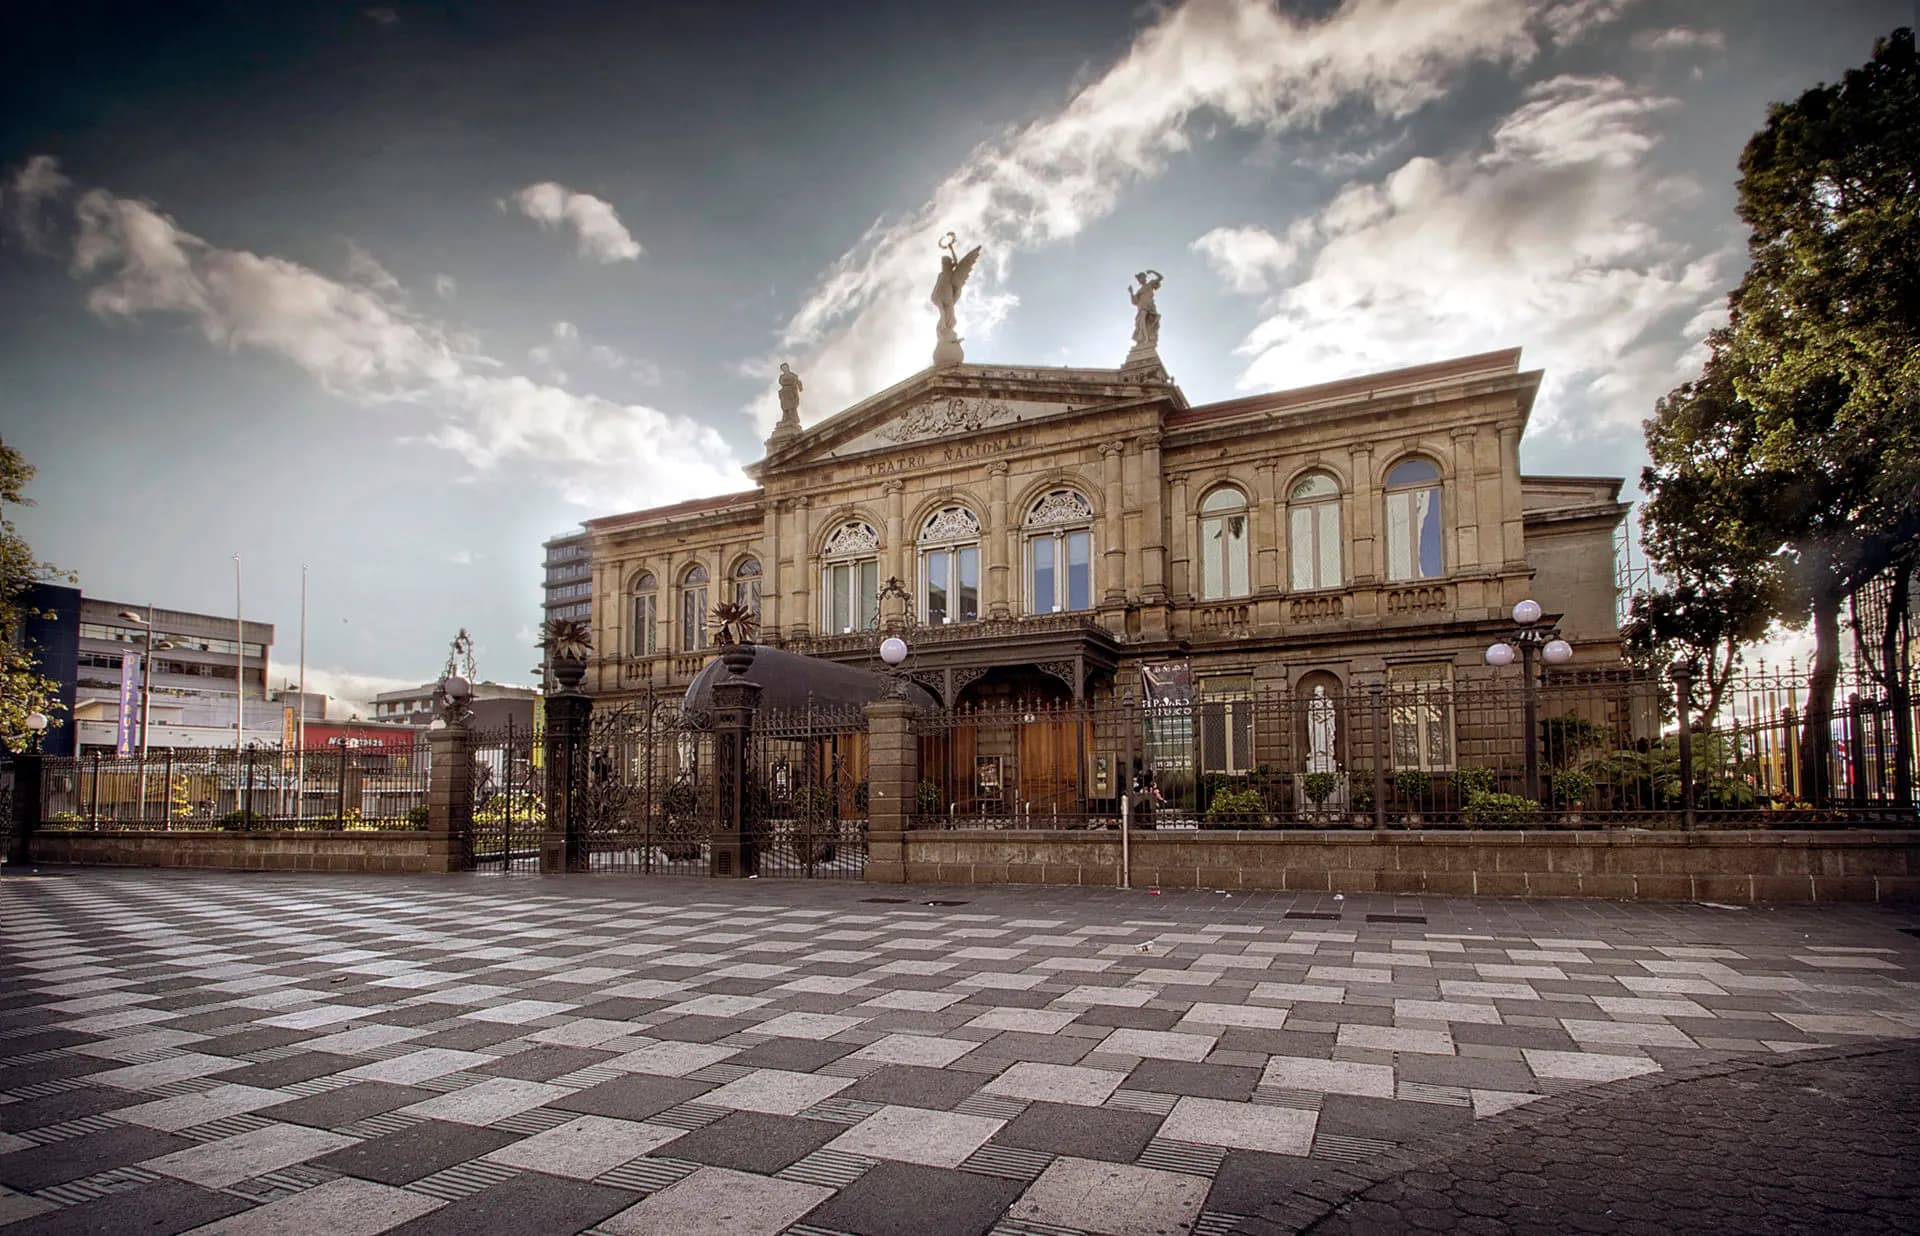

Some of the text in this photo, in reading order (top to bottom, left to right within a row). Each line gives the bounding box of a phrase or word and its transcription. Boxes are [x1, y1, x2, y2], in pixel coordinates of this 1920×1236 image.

[866, 437, 1024, 475] TEATRO NACIONAL
[121, 655, 136, 752] DISFRUTA
